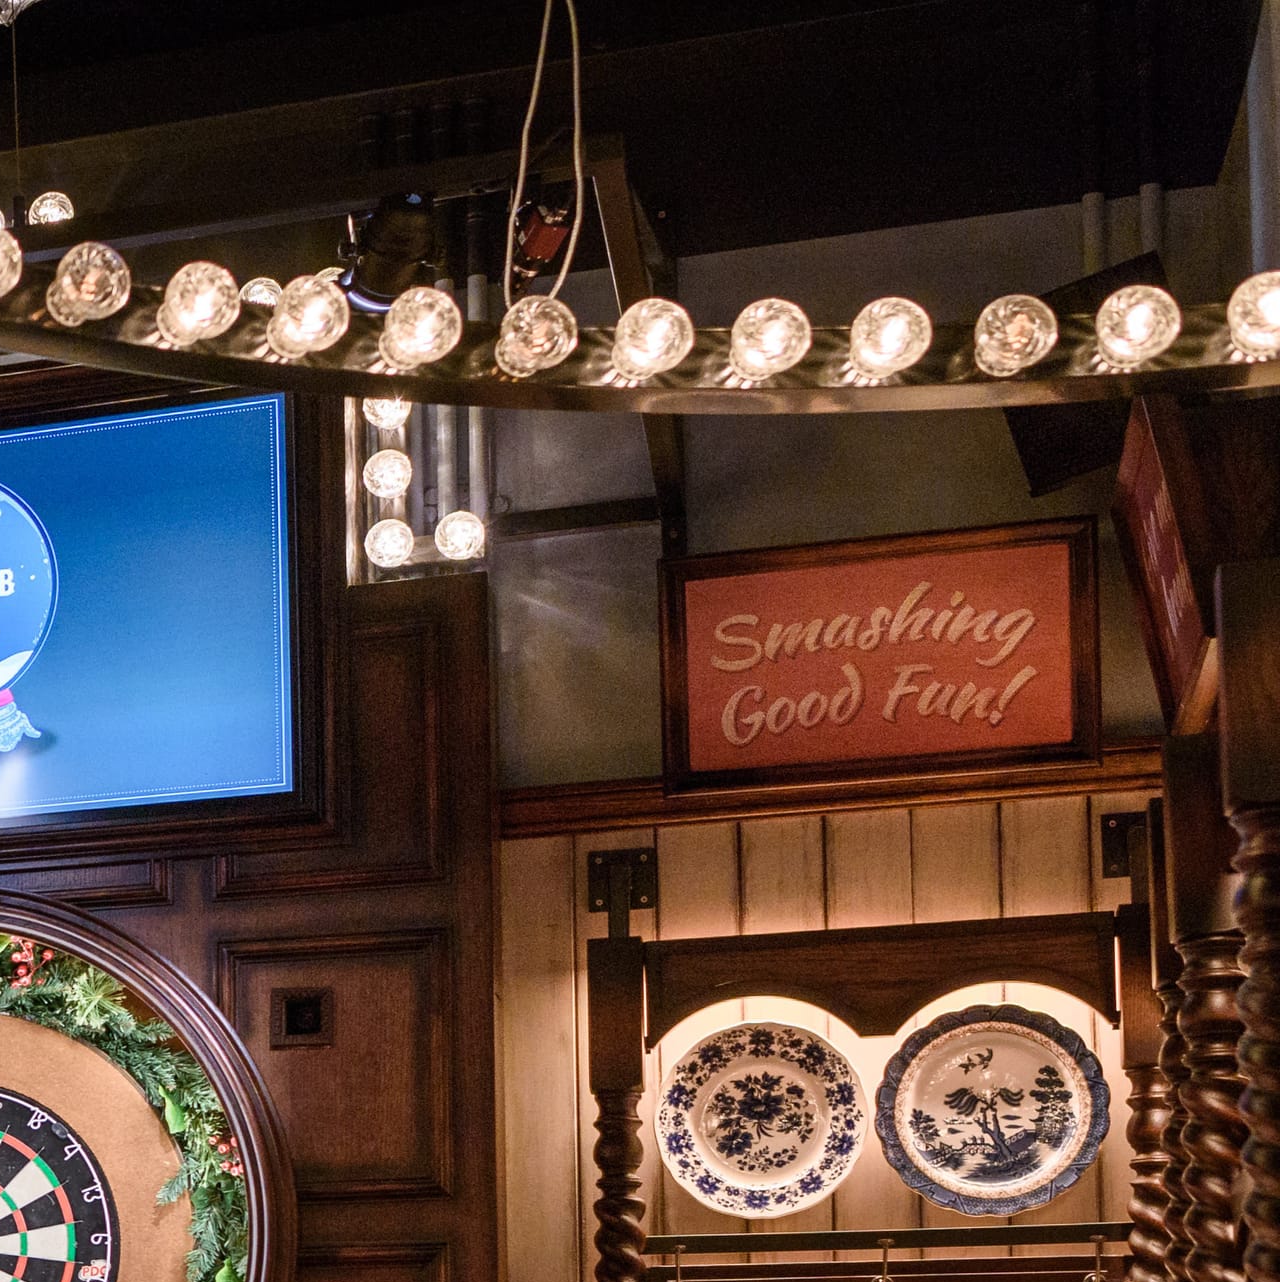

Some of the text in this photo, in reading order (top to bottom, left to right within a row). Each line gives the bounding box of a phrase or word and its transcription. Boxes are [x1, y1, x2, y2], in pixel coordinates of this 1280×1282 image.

[710, 581, 1036, 671] Smashing
[721, 662, 1039, 747] Good Fun!
[26, 1107, 48, 1130] 18
[64, 1144, 82, 1161] 4
[81, 1179, 103, 1204] 13
[90, 1232, 110, 1246] 6
